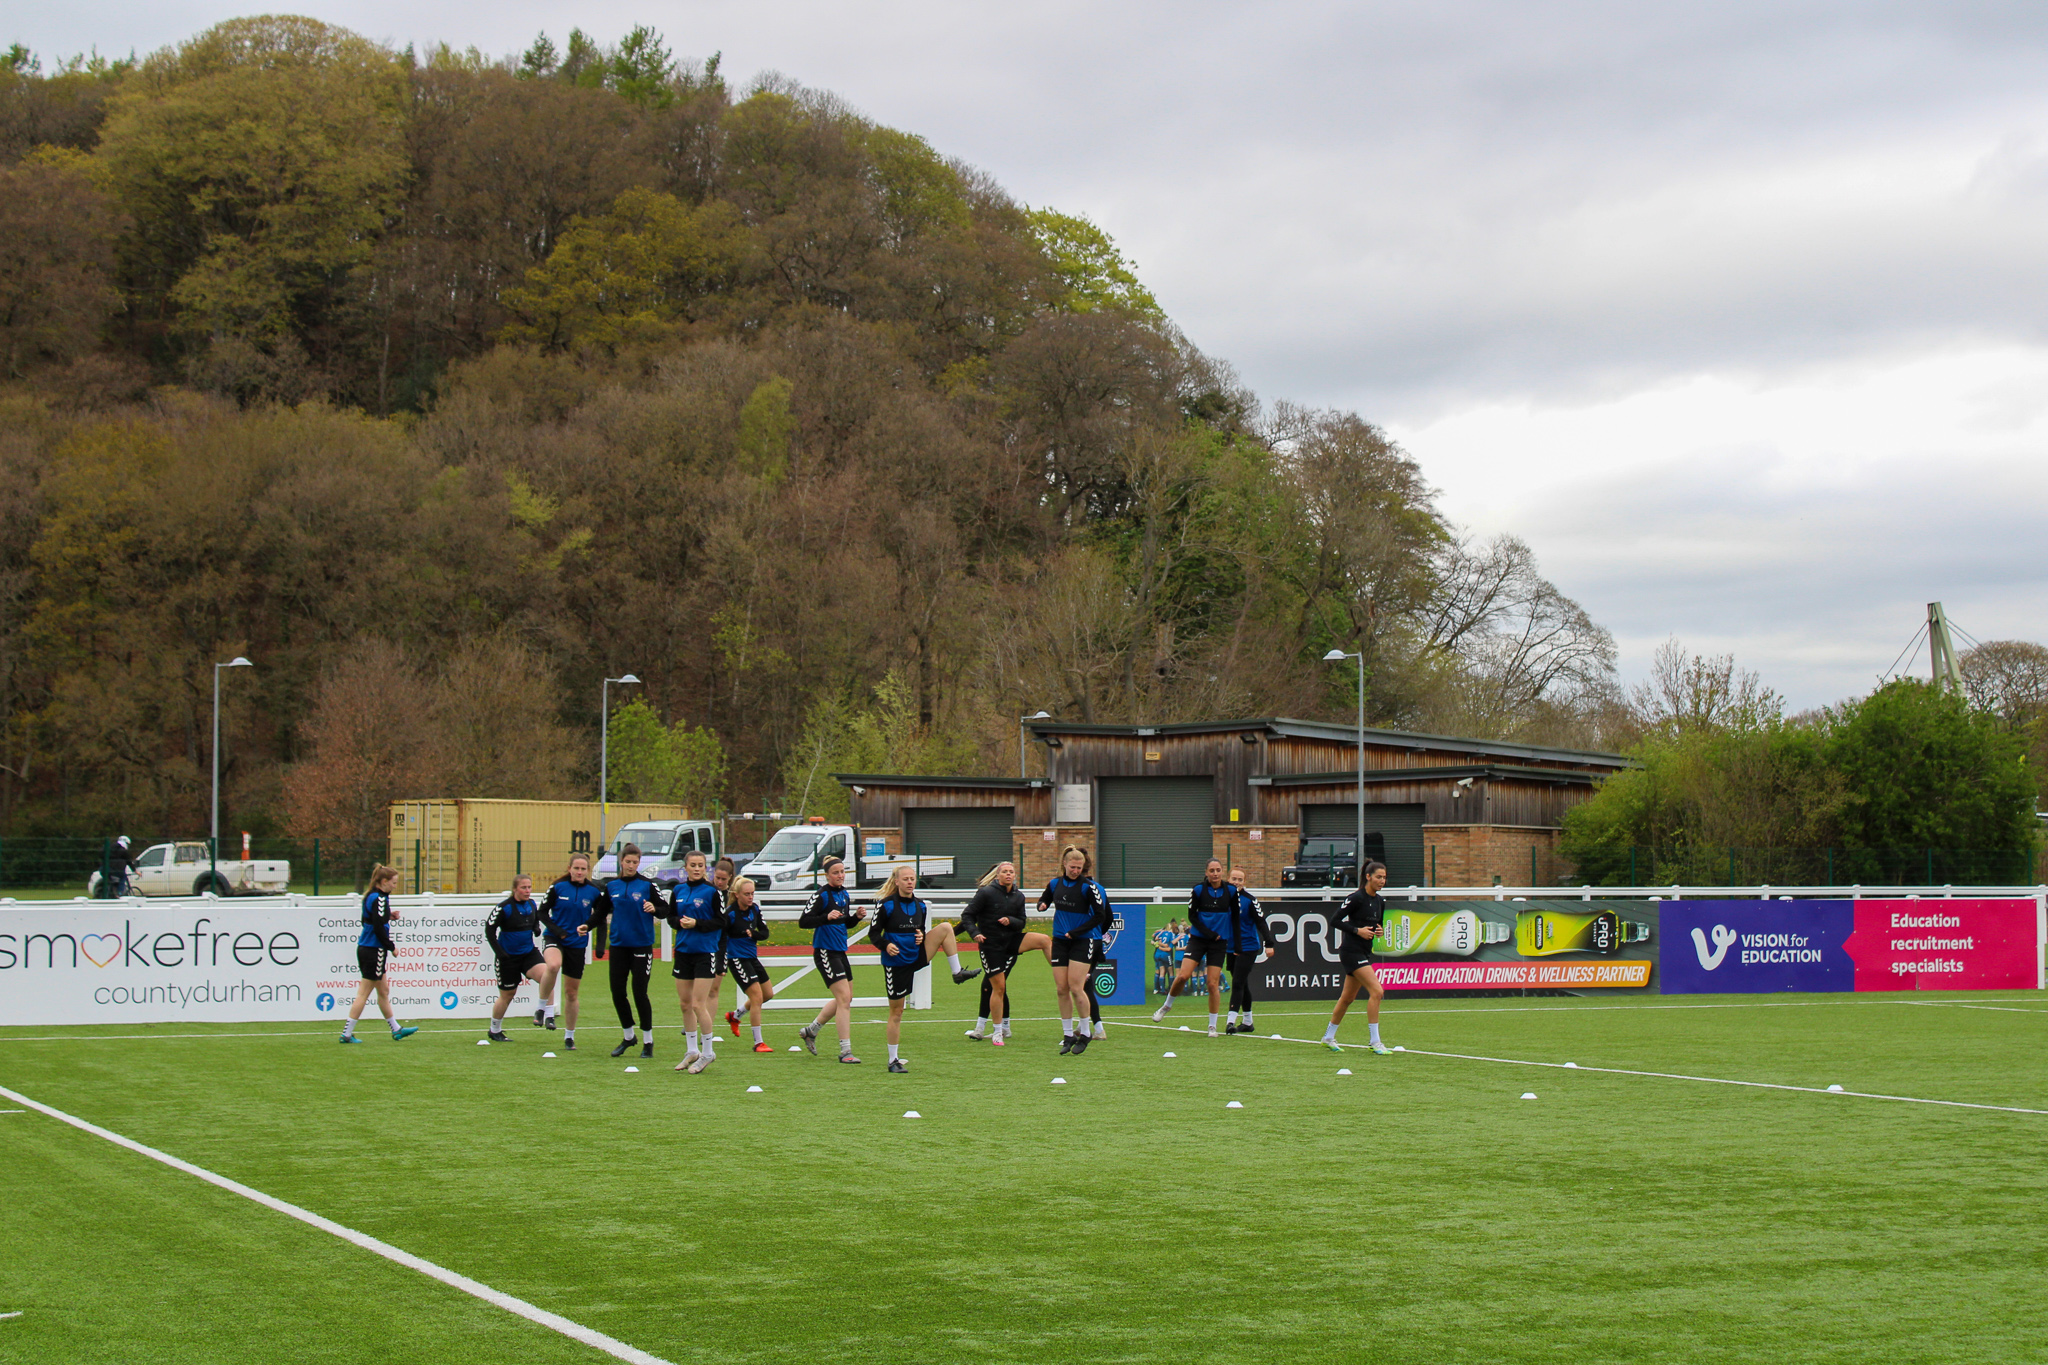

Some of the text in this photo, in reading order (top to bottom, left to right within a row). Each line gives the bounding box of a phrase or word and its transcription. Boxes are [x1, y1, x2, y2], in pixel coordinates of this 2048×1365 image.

[318, 917, 363, 928] Contac
[390, 917, 419, 929] oday
[421, 917, 438, 927] for
[440, 917, 478, 927] advice
[1891, 913, 1960, 928] Education
[319, 932, 347, 943] from
[405, 933, 432, 944] stop
[434, 931, 483, 944] smoking
[1741, 933, 1809, 948] VISION for
[1891, 935, 1974, 951] recruitment
[427, 947, 448, 957] 772
[450, 946, 481, 957] 0565
[1741, 949, 1822, 964] EDUCATION
[330, 965, 344, 973] or
[427, 963, 439, 972] to
[441, 962, 478, 972] 62277
[479, 963, 492, 972] or
[1891, 958, 1964, 977] specialists
[1265, 974, 1340, 988] HYDRATE
[1376, 966, 1645, 985] OFFICIAL HYDRATION DRINKS & WELLNESS PARTNER
[94, 979, 301, 1009] countydurham
